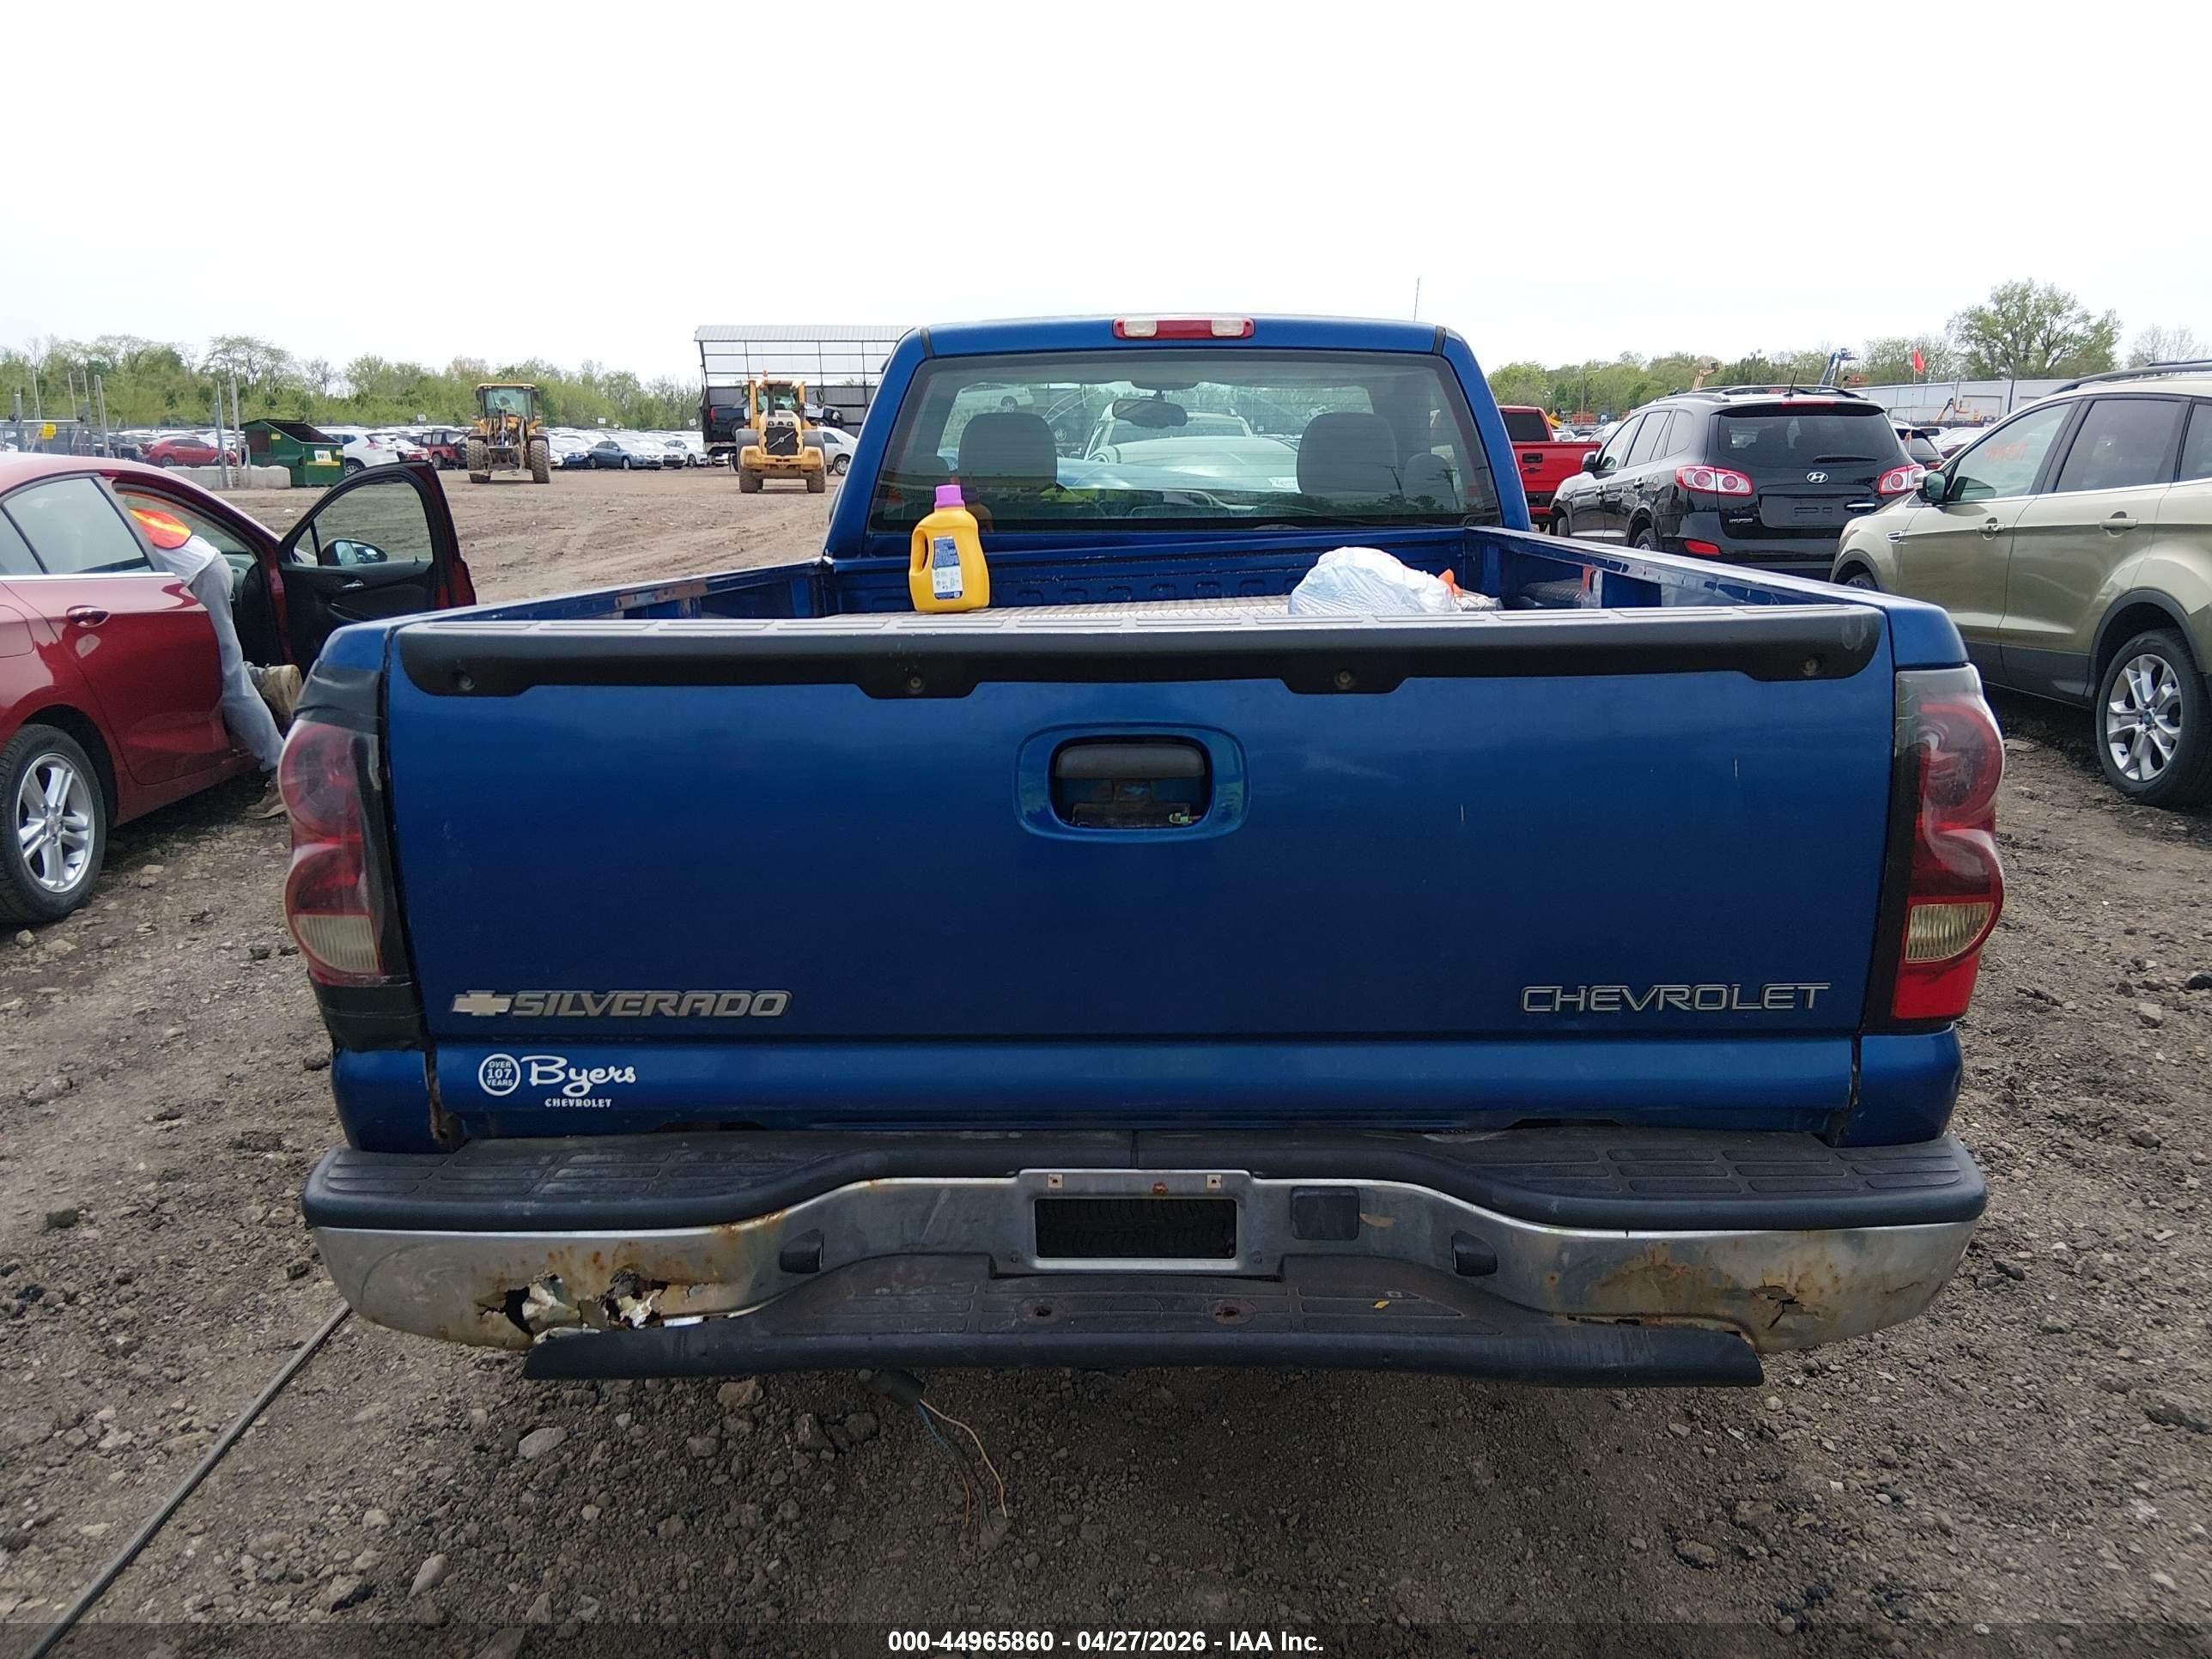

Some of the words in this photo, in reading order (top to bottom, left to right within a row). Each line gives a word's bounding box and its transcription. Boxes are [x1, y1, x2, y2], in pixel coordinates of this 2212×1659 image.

[513, 990, 793, 1017] SILVERADO
[1522, 982, 1831, 1012] CHEVROLET
[487, 1068, 513, 1079] 107
[520, 1054, 636, 1097] Byers
[544, 1097, 612, 1108] CHEVROLET
